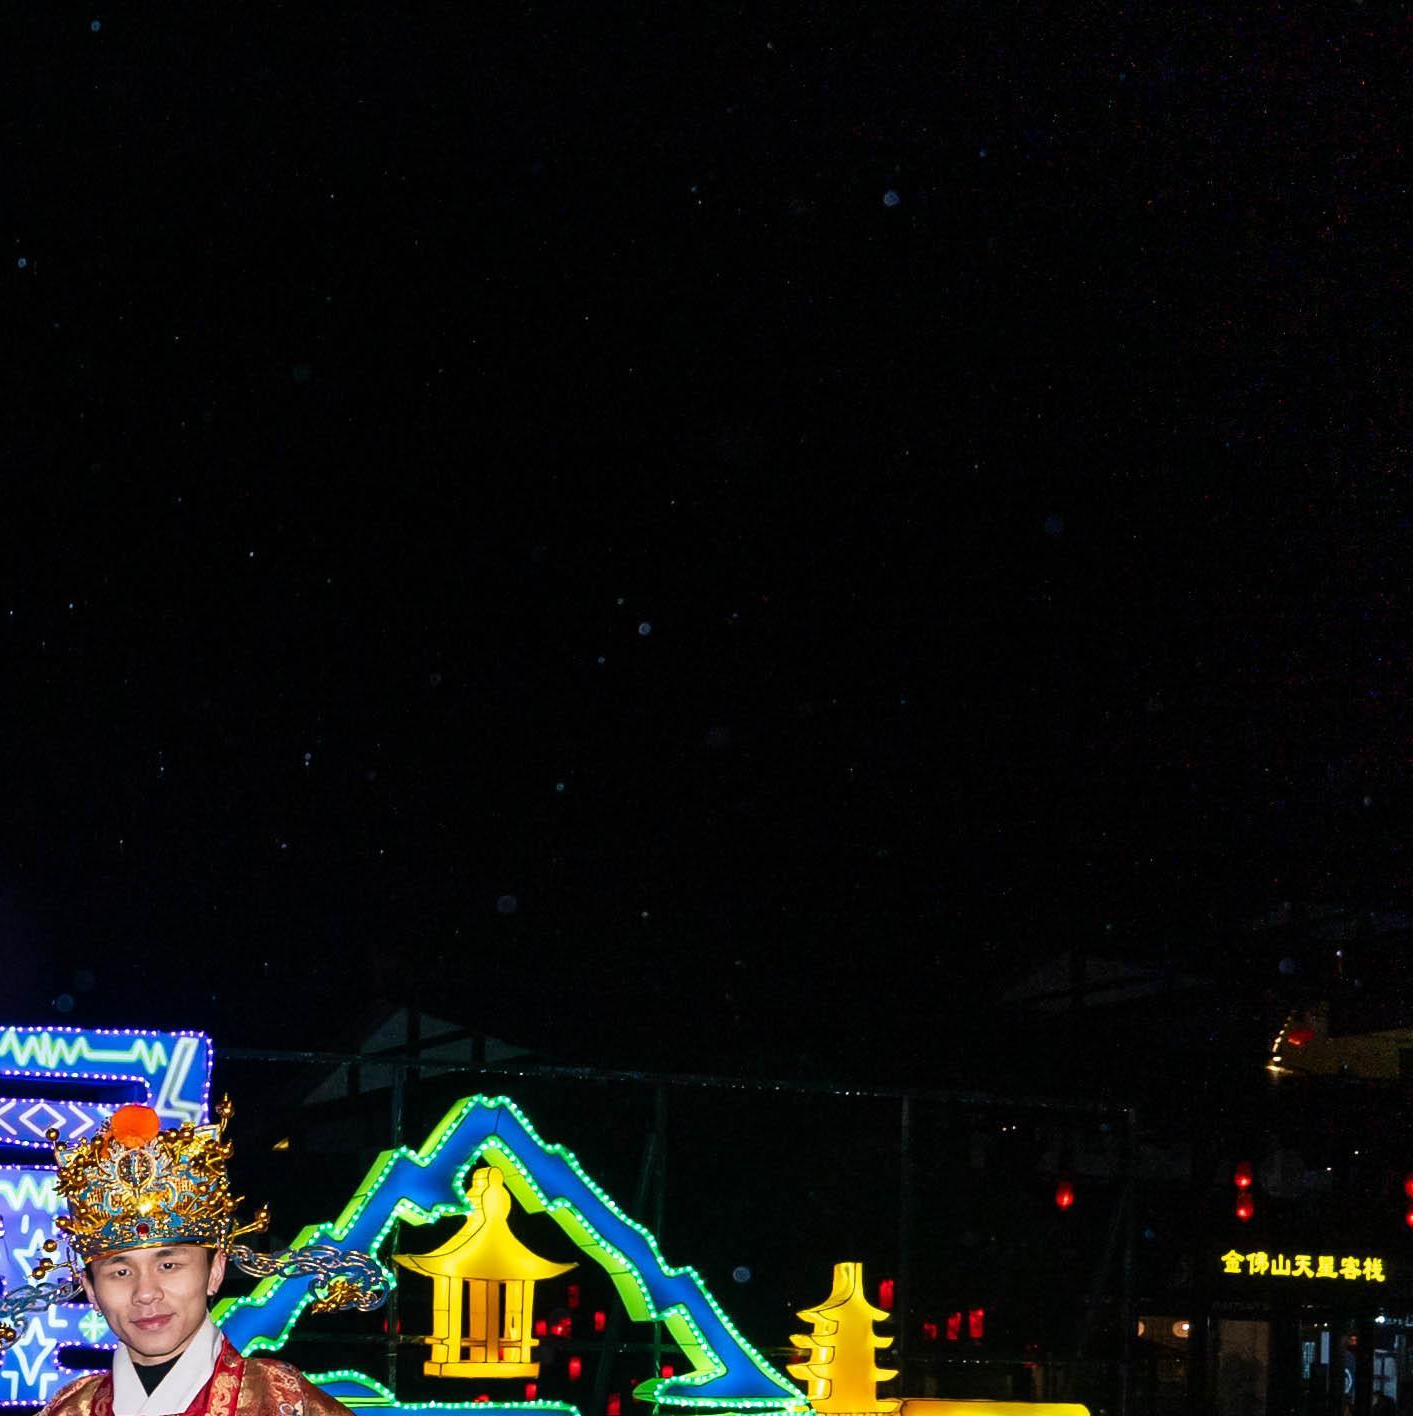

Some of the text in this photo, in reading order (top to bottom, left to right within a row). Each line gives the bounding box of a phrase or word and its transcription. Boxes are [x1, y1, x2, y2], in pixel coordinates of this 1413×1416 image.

[1221, 1249, 1386, 1282] 金佛山天星客栈
